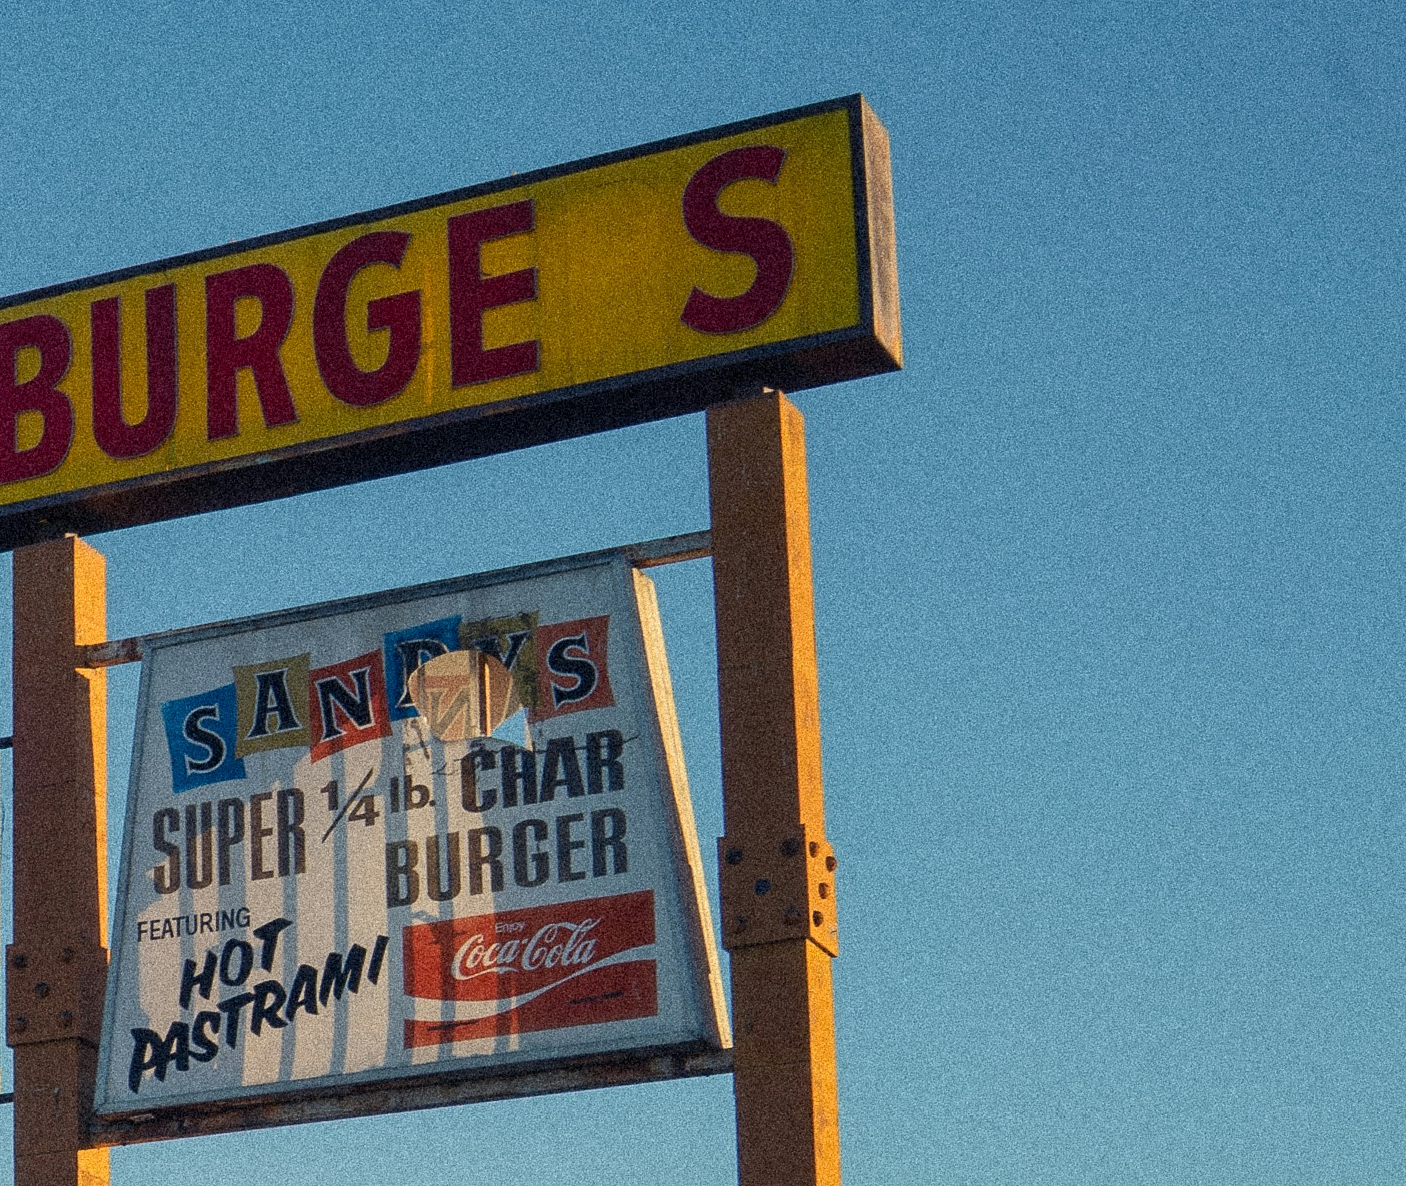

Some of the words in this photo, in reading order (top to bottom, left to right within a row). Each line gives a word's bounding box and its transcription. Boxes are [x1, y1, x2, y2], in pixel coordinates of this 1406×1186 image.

[153, 786, 307, 895] SUPER
[320, 768, 382, 843] 1/4
[462, 729, 625, 814] CHAR
[387, 807, 629, 906] BURGER
[137, 907, 251, 943] FEATURING
[180, 919, 293, 1010] HOT
[451, 917, 603, 982] Coca-Cola
[495, 920, 526, 934] Enjoy
[128, 936, 389, 1093] PASTRAMI
